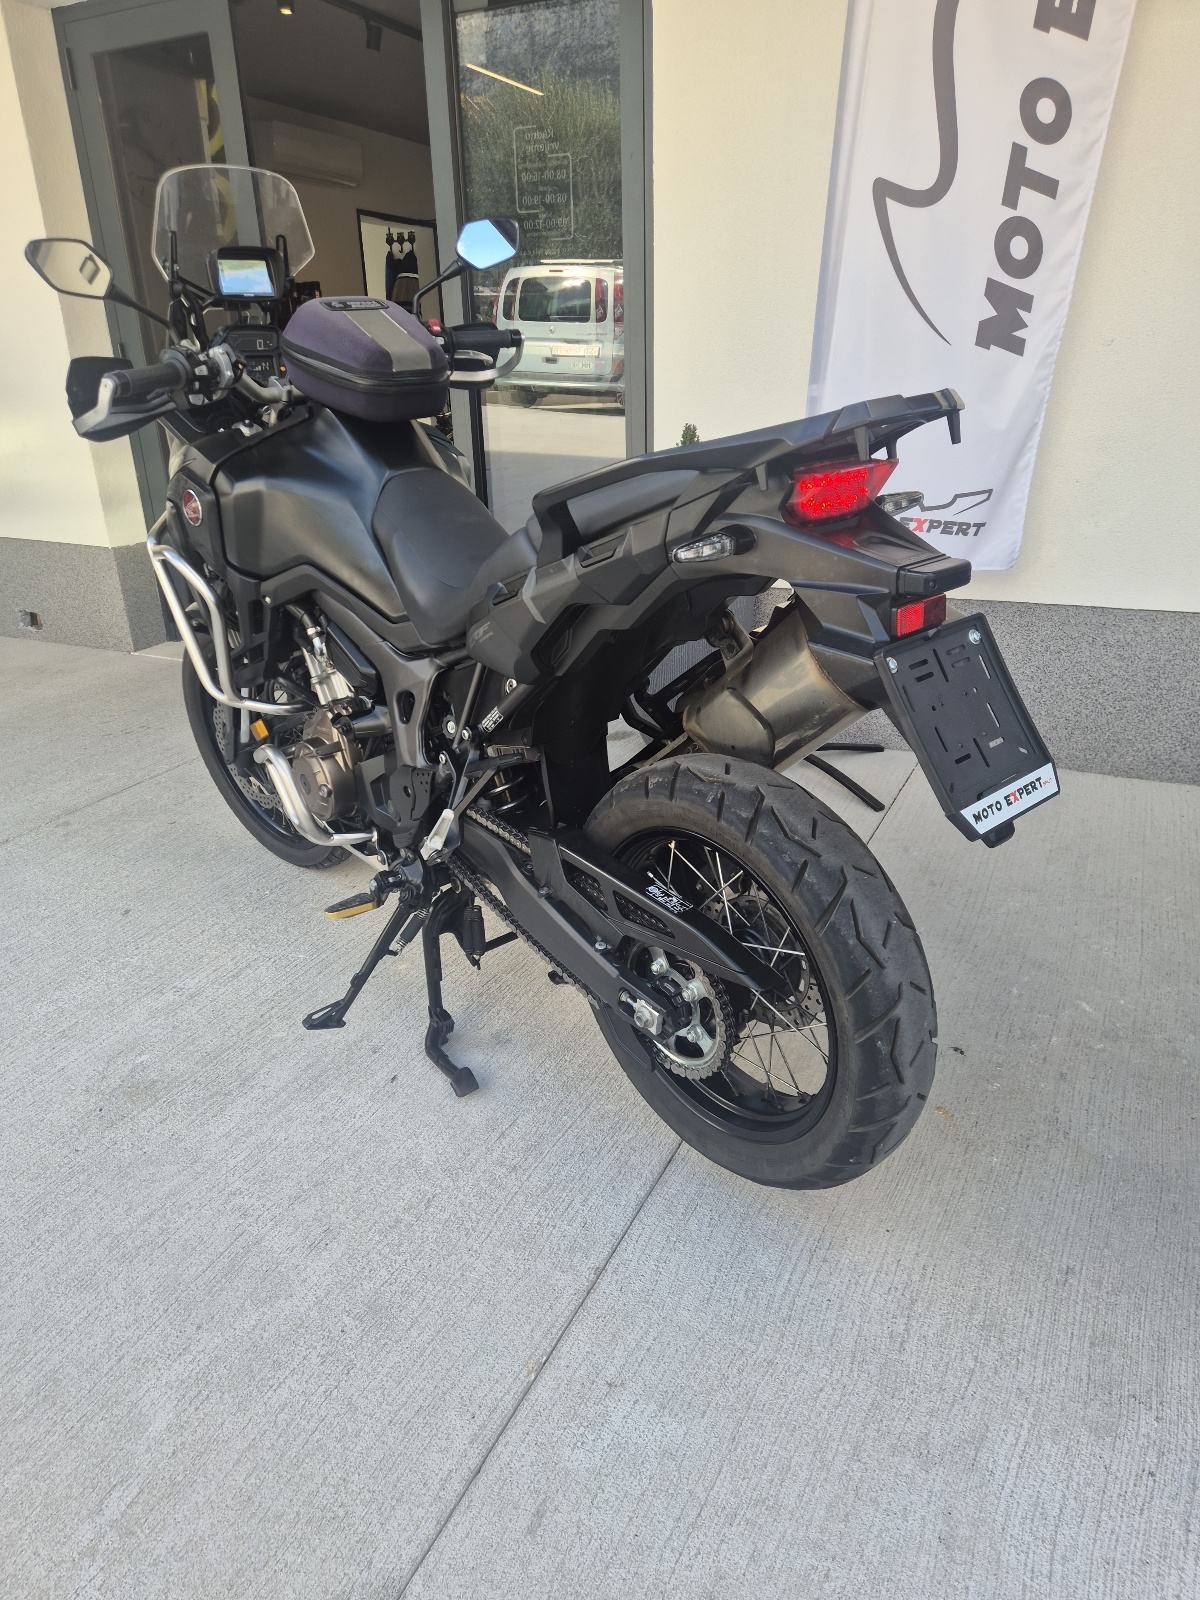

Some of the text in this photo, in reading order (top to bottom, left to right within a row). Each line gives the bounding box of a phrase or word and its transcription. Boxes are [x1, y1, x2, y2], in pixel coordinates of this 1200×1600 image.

[975, 77, 1072, 357] MOTO
[973, 801, 1002, 825] MOTO
[1004, 777, 1043, 807] EXPERT
